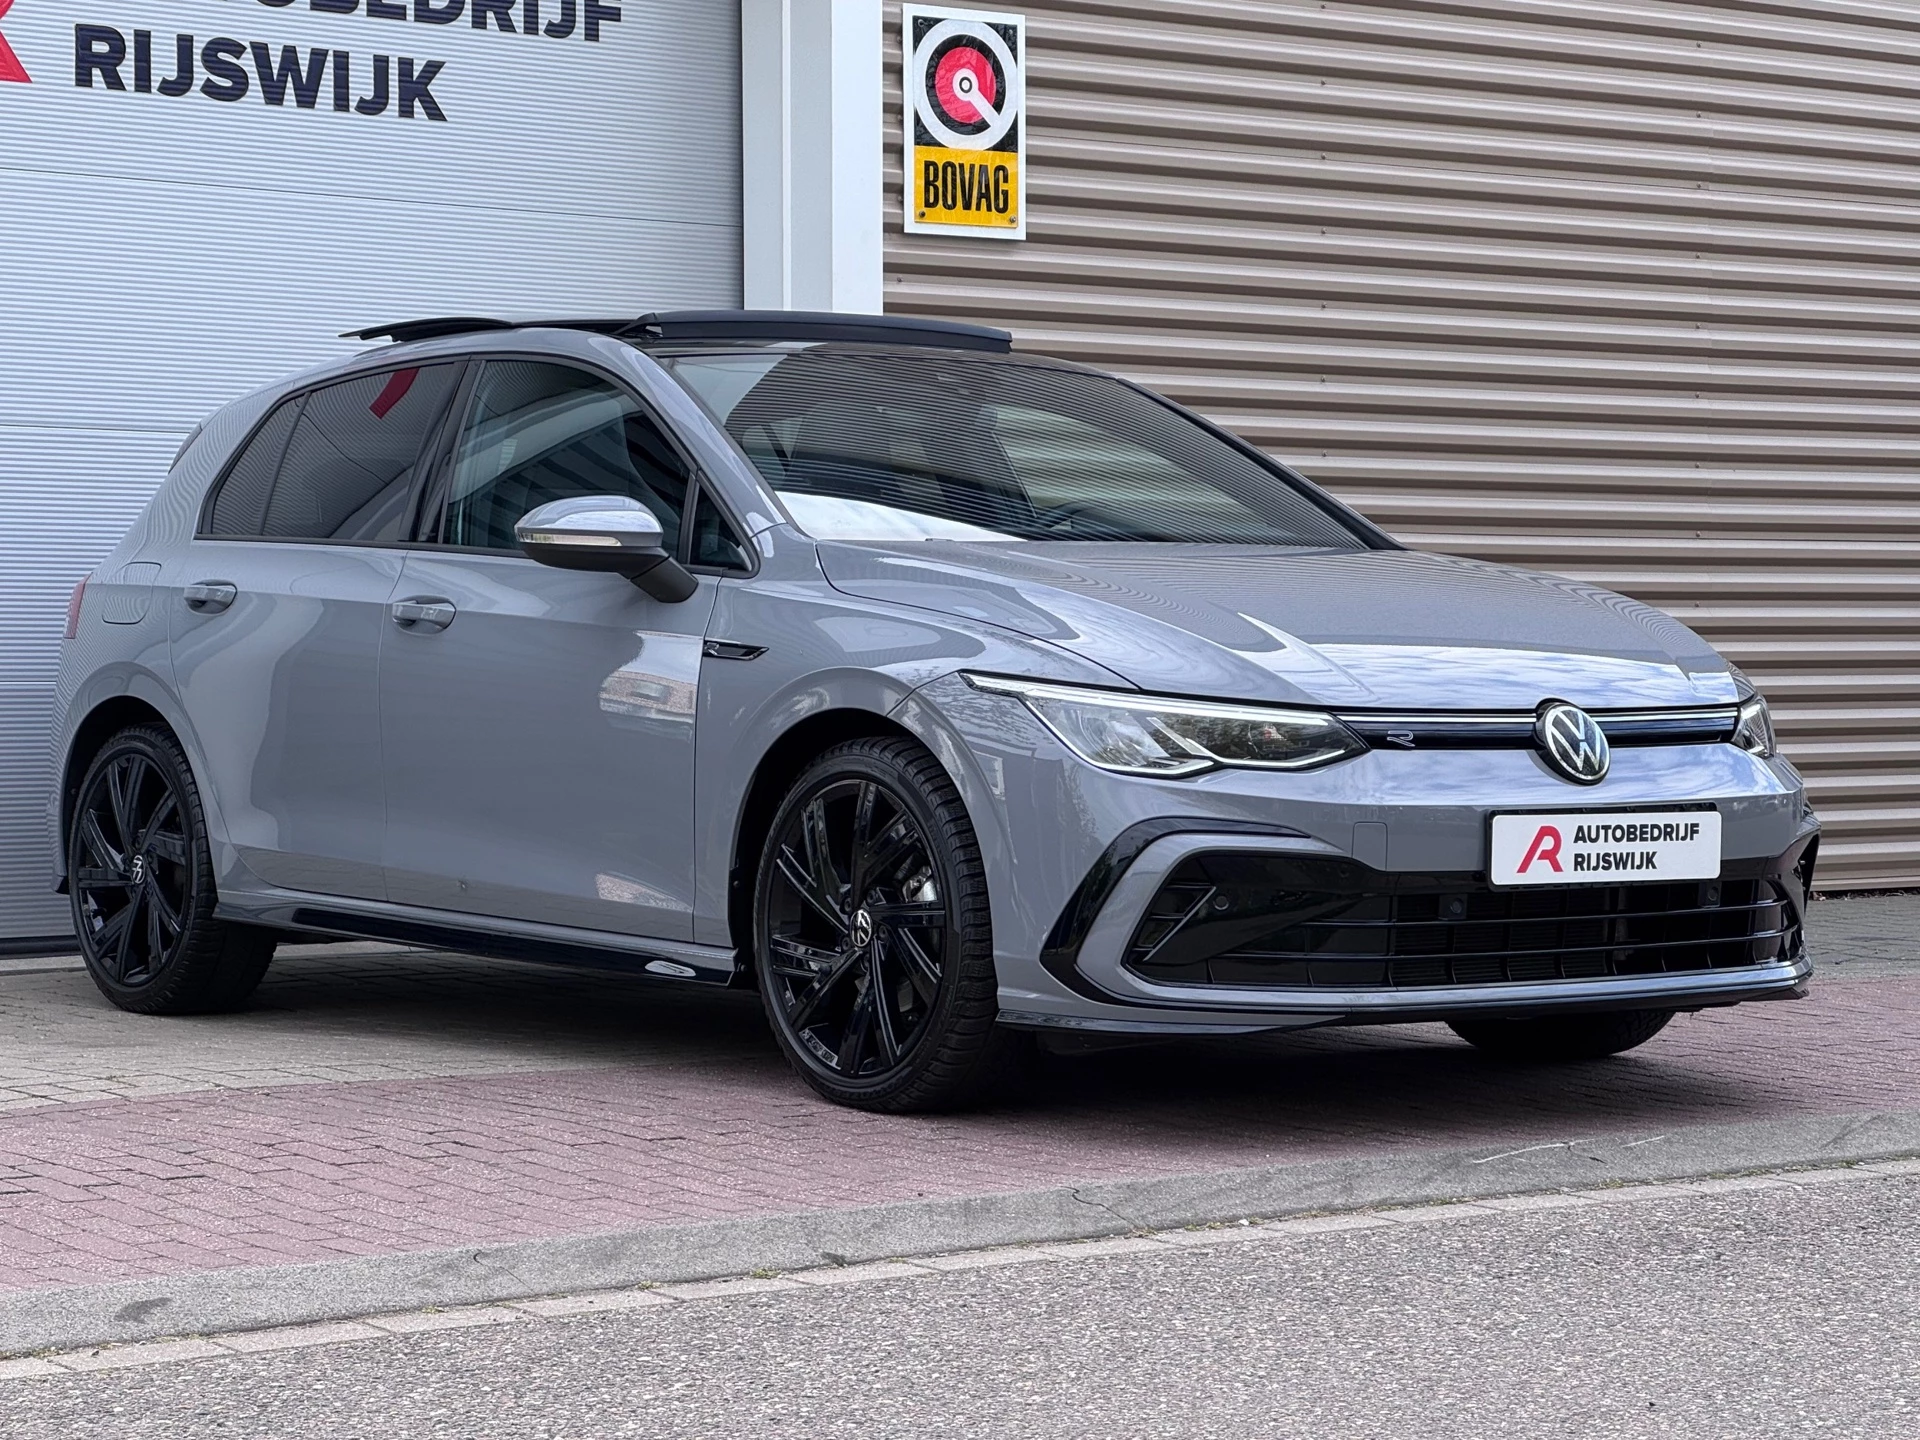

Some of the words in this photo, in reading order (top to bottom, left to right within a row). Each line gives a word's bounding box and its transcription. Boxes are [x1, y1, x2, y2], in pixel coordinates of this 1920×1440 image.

[75, 23, 448, 121] RIJSWIJK
[924, 160, 1010, 214] BOVAG
[1573, 823, 1700, 844] AUTOBEDRIJF
[1573, 851, 1658, 872] RIJSWIJK
